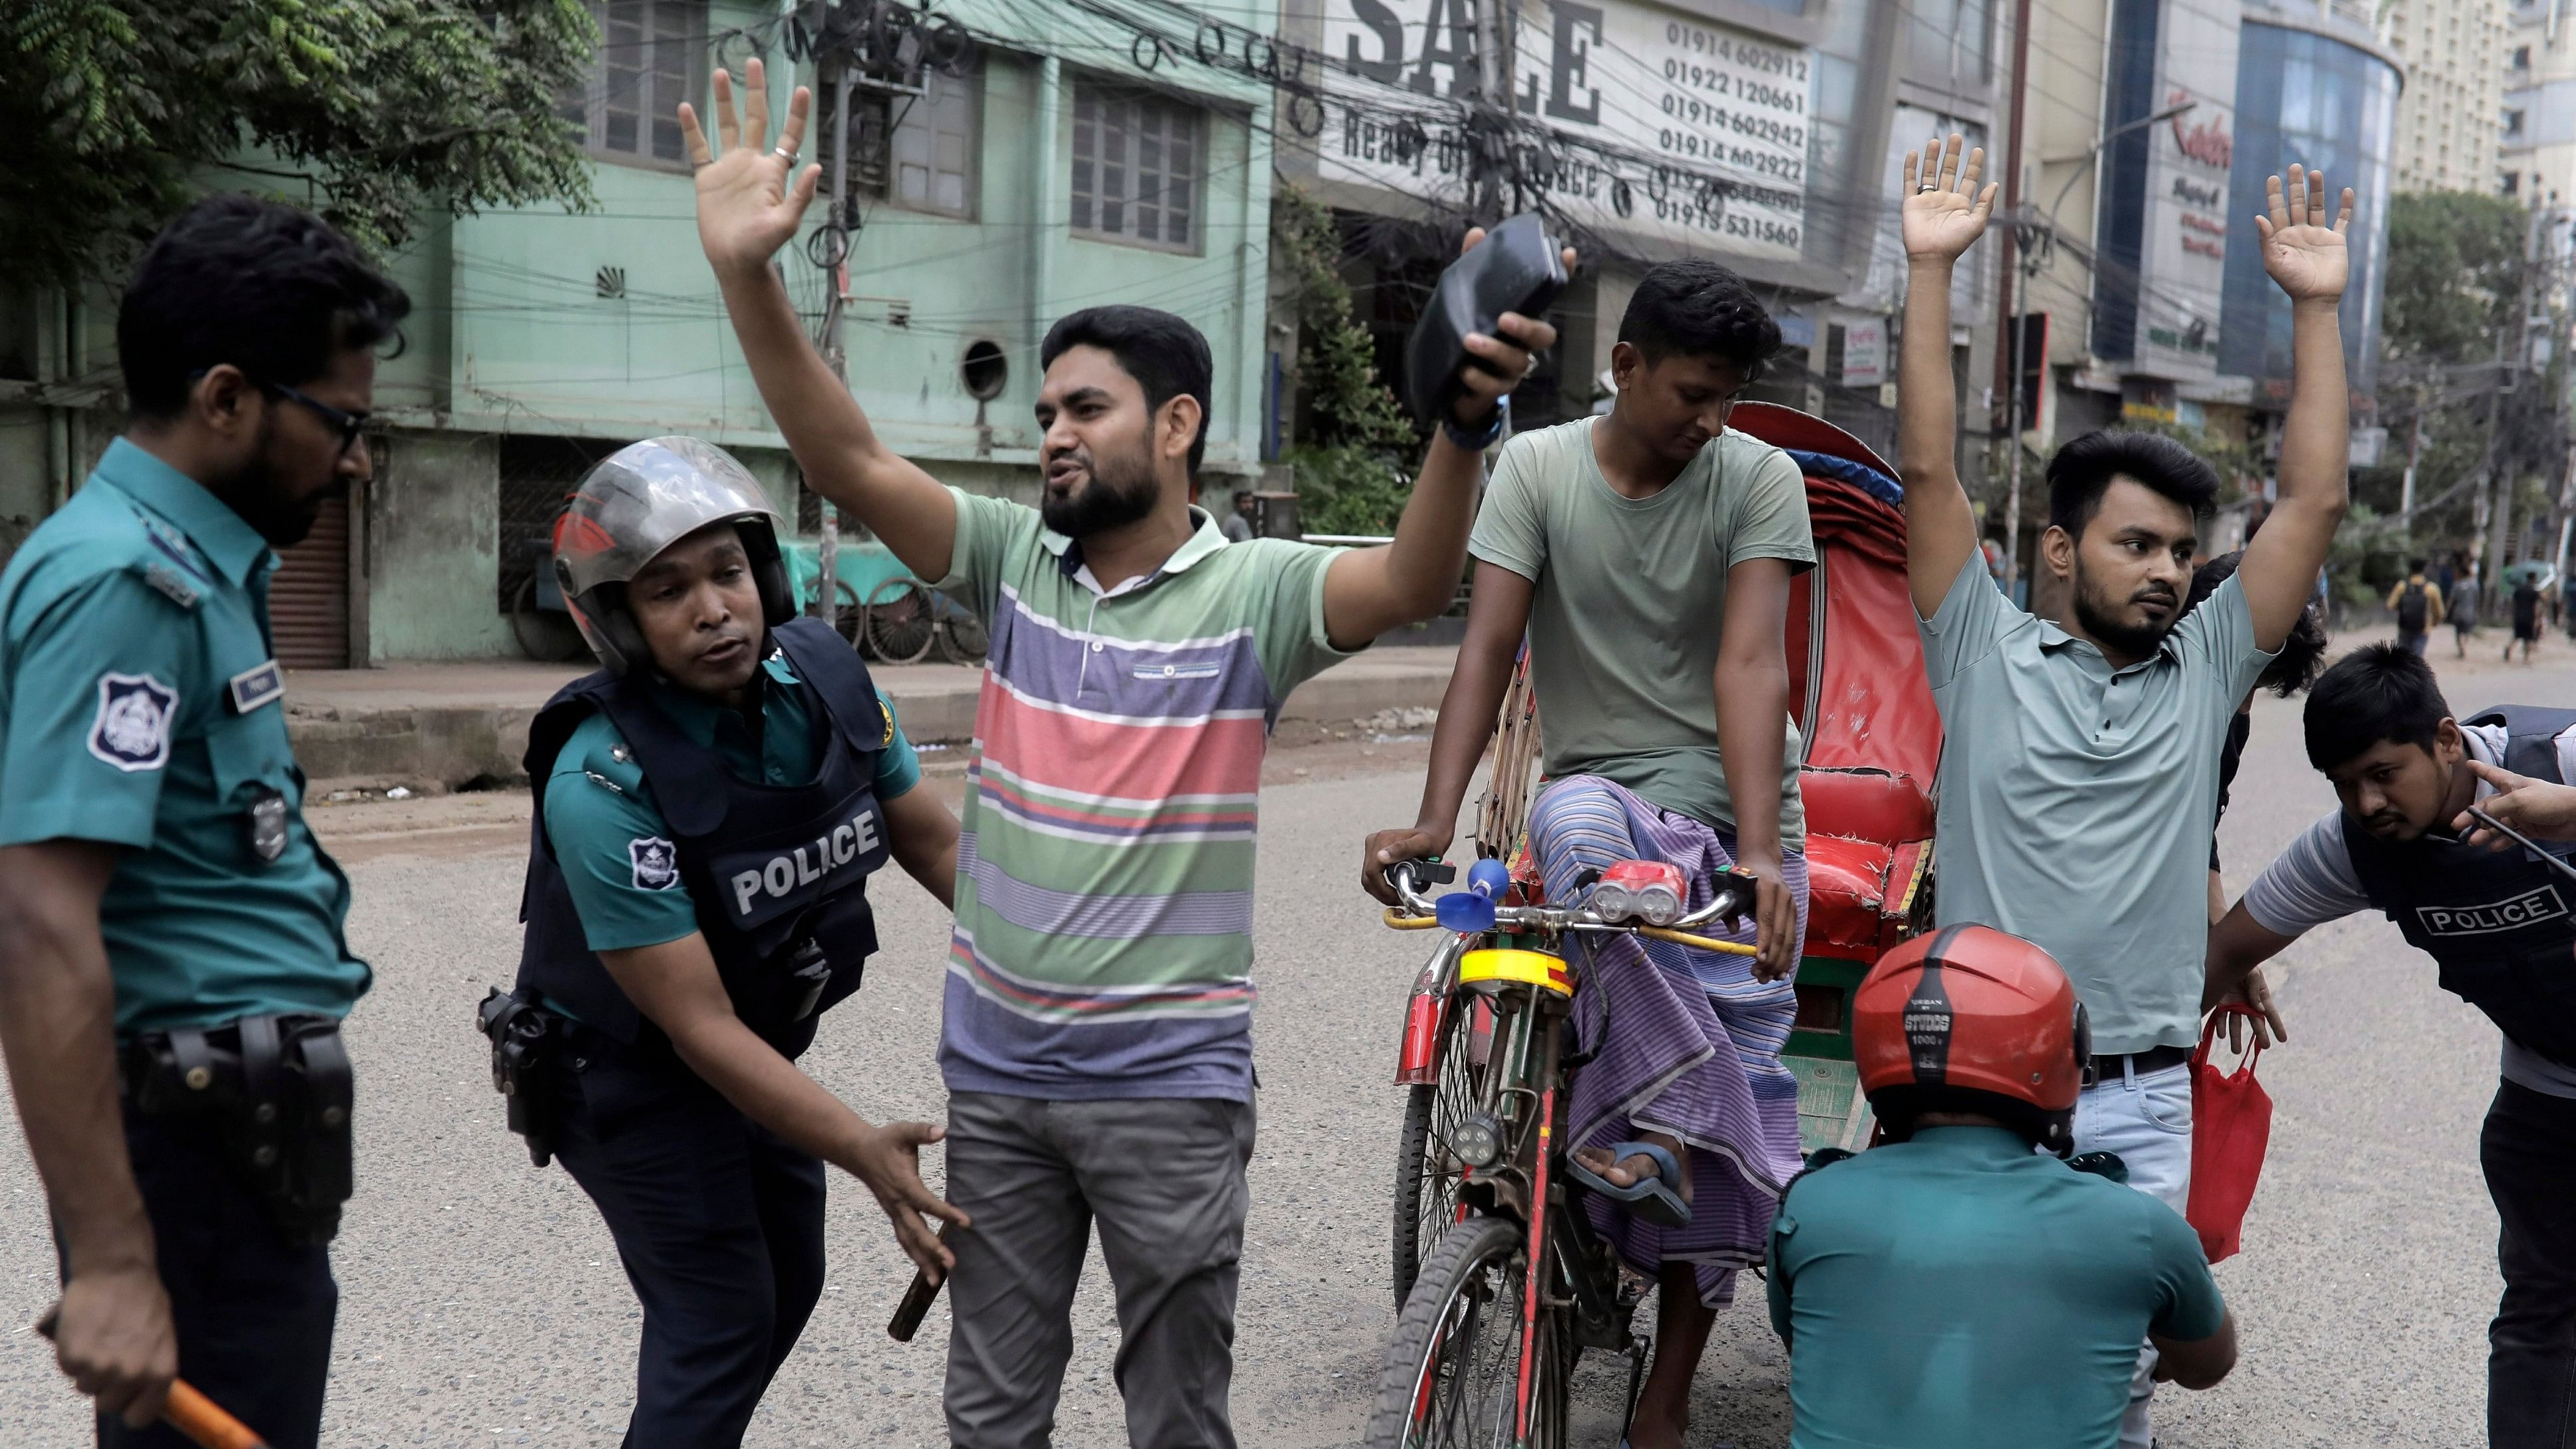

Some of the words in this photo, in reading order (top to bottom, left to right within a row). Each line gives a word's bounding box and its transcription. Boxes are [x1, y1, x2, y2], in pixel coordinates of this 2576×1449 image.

[1666, 21, 1730, 60] 01914
[1736, 45, 1807, 83] 602912
[1664, 57, 1729, 95] 01922
[1736, 77, 1803, 115] 120661
[1662, 93, 1727, 129] 01914
[1732, 110, 1803, 148] 602942
[1660, 128, 1725, 160] 01914
[1730, 147, 1801, 180] 602922
[1726, 214, 1799, 247] 531560
[731, 810, 879, 915] POLICE
[2432, 896, 2549, 930] POLICE
